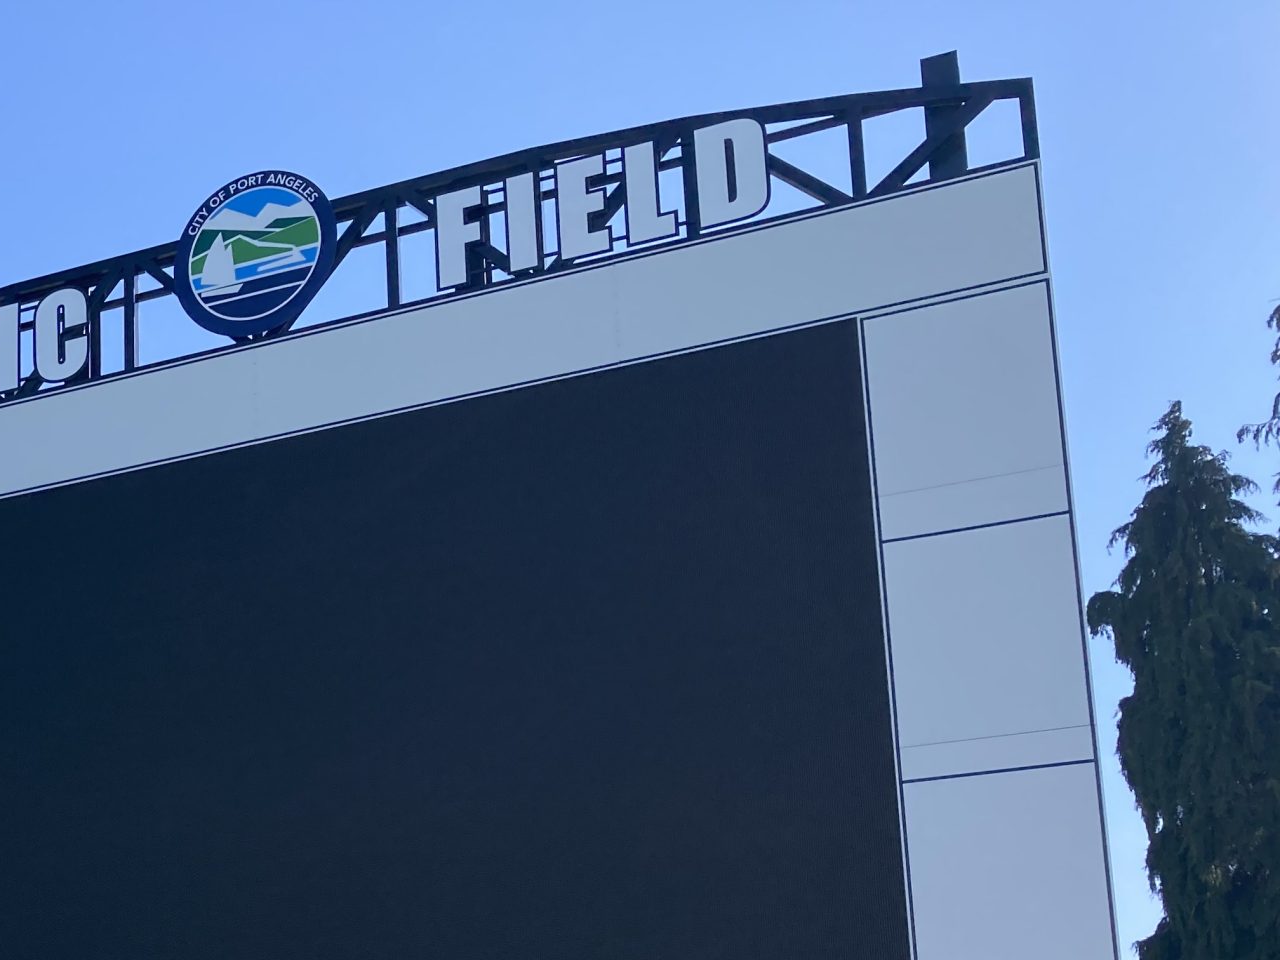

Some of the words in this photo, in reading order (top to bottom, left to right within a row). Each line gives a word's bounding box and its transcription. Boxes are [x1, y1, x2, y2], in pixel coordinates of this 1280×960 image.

[188, 208, 209, 236] CITY
[209, 190, 226, 208] OF
[228, 173, 264, 195] PORT
[266, 173, 319, 203] ANGELES
[434, 118, 770, 292] FIELD
